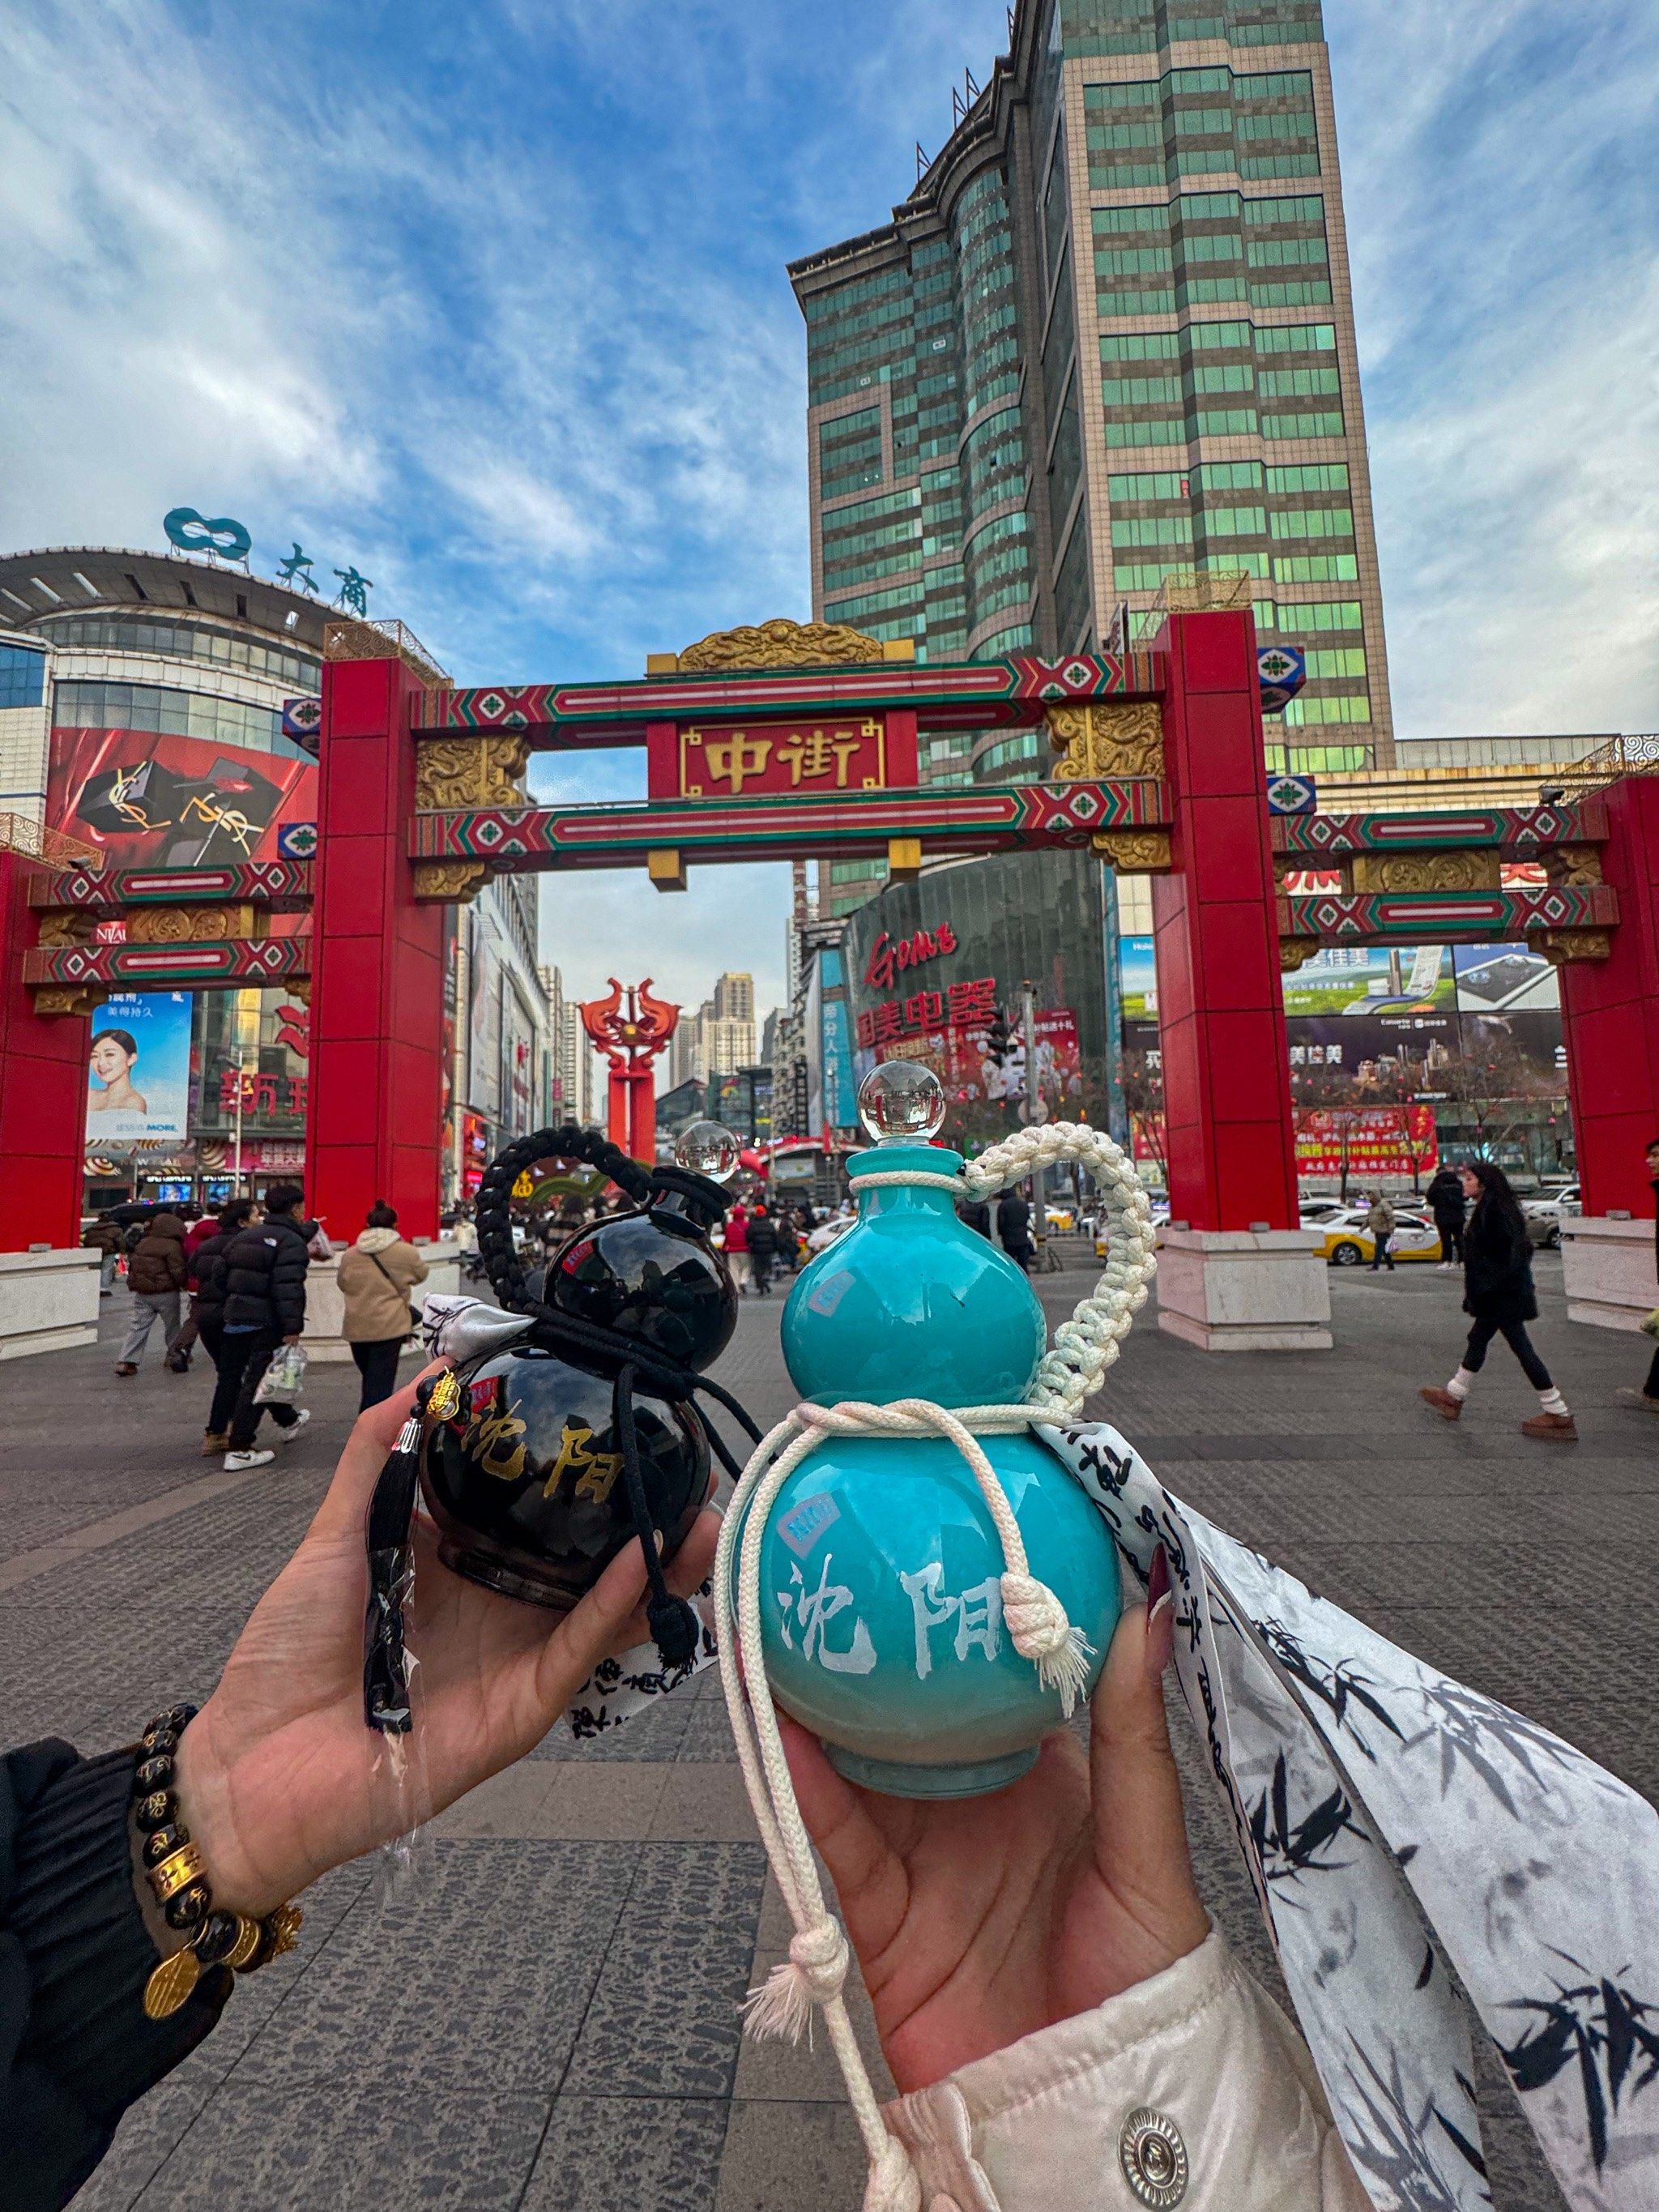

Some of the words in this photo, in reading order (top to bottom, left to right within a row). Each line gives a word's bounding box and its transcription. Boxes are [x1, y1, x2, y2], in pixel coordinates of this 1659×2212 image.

[275, 541, 373, 618] 大商
[704, 729, 861, 794] 中街
[856, 977, 996, 1048] 国美电器
[461, 1399, 626, 1505] 沈阳
[776, 1552, 1003, 1680] 沈阳
